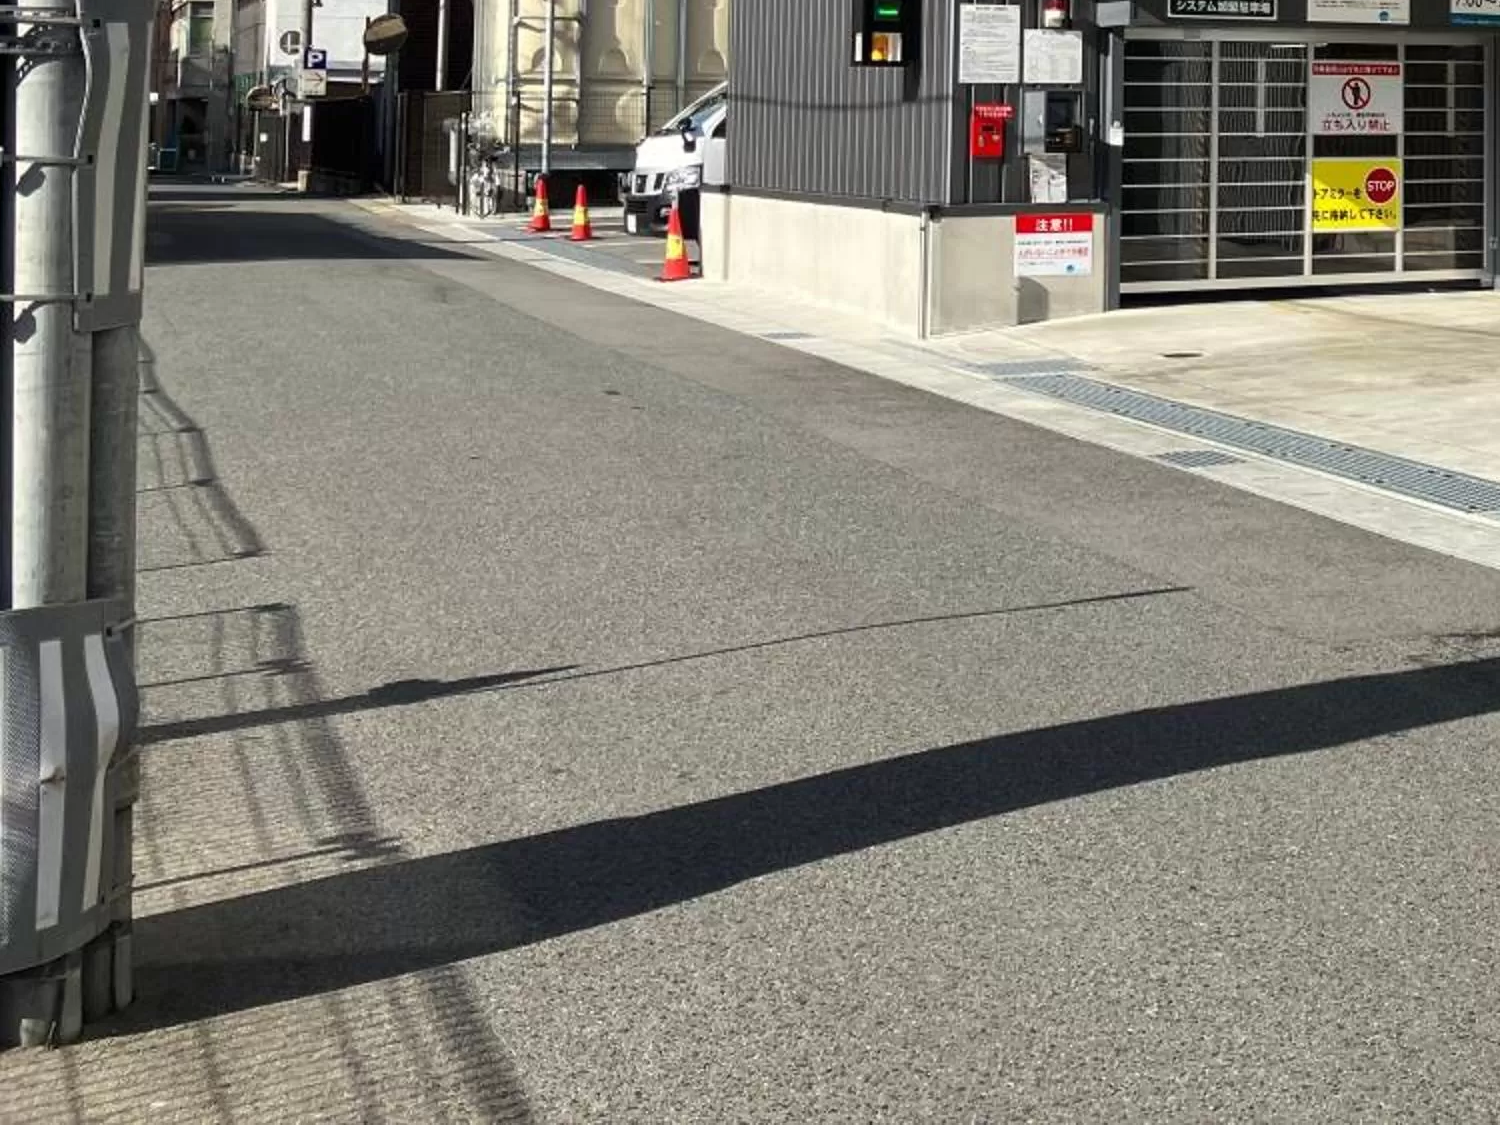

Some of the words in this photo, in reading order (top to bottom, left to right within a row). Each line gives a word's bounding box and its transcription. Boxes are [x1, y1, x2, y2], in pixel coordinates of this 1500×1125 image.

[308, 52, 324, 68] P
[1321, 118, 1391, 131] 立ち入り禁止
[1367, 180, 1395, 192] STOP
